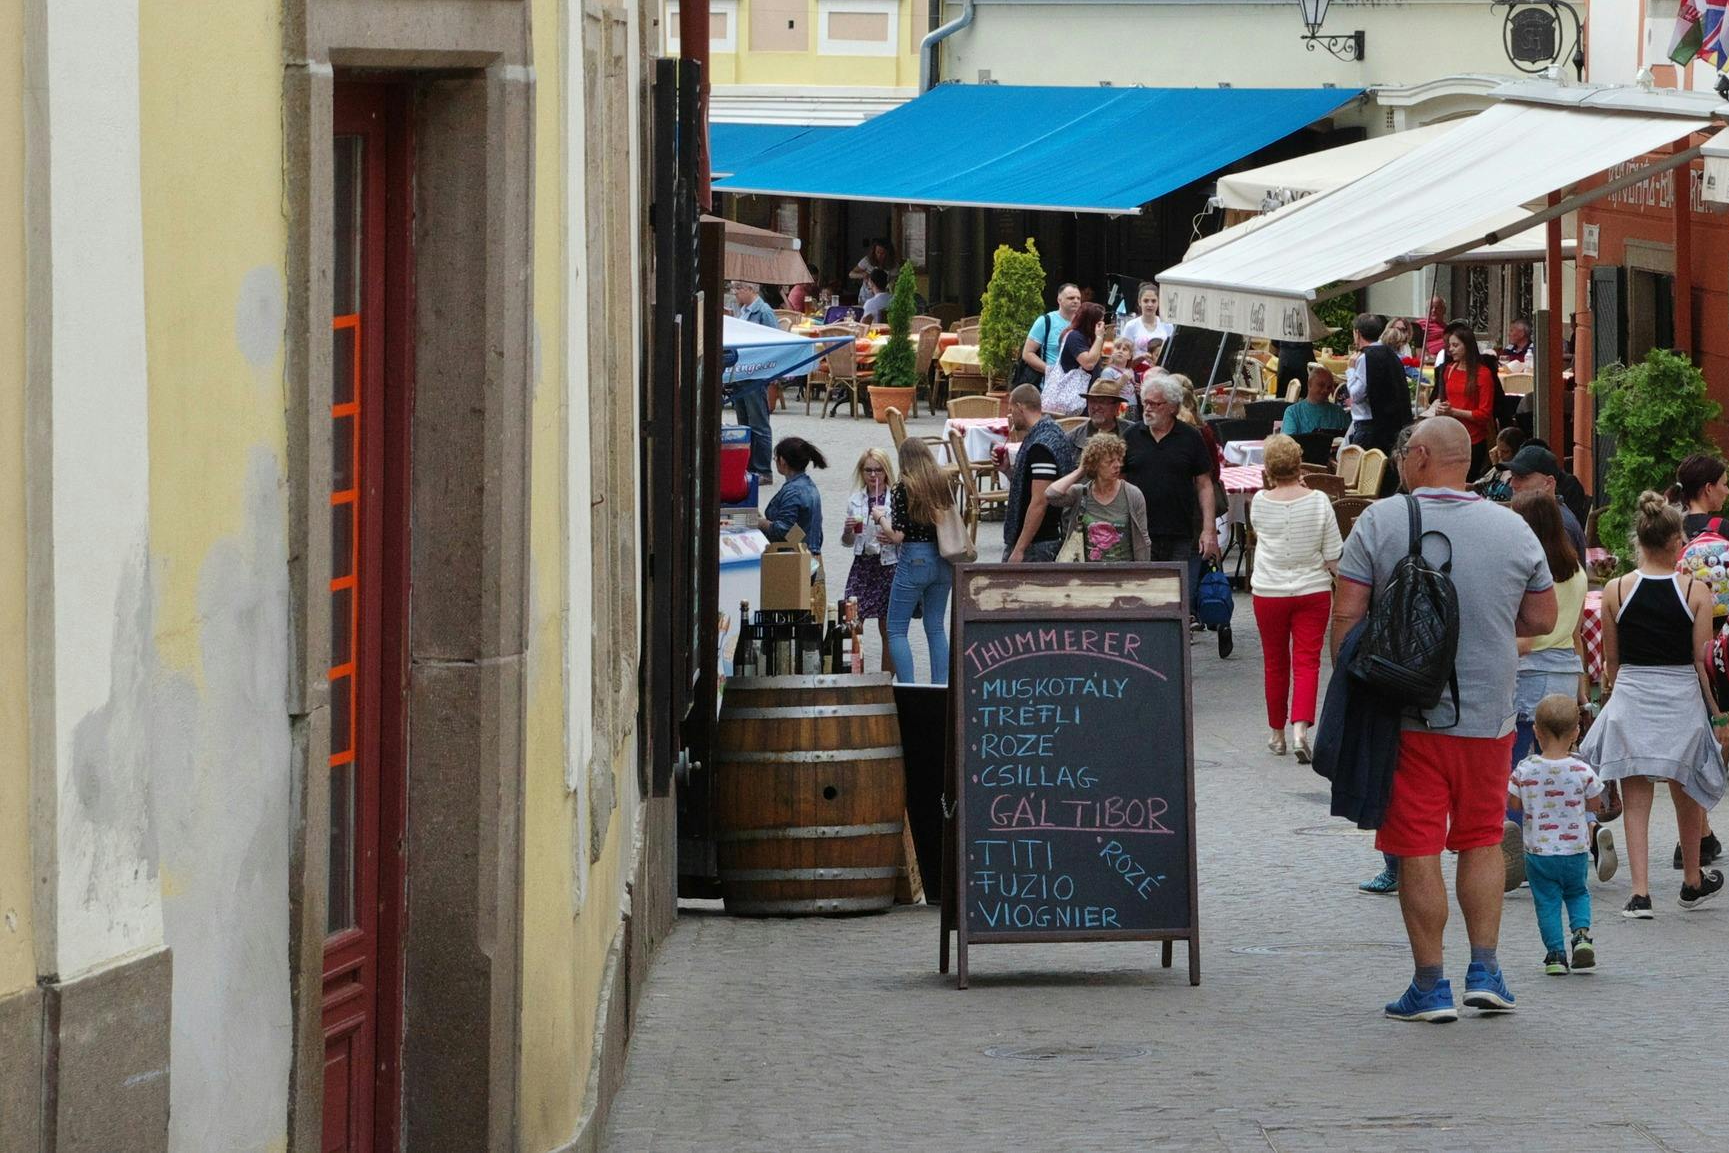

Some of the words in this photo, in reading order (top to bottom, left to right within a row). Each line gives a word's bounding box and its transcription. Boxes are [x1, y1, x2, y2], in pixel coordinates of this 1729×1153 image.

[964, 629, 1142, 672] THUMMERER
[981, 672, 1129, 701] MUSKOTÁLY
[980, 727, 1060, 758] ROZÉ
[980, 765, 1098, 789] CSILLAG
[990, 791, 1056, 829] GÁL
[1062, 796, 1170, 830] TIBOR
[974, 840, 1054, 871] TITI
[1099, 840, 1167, 901] ROZÉ
[977, 902, 1122, 928] VIOGNIER
